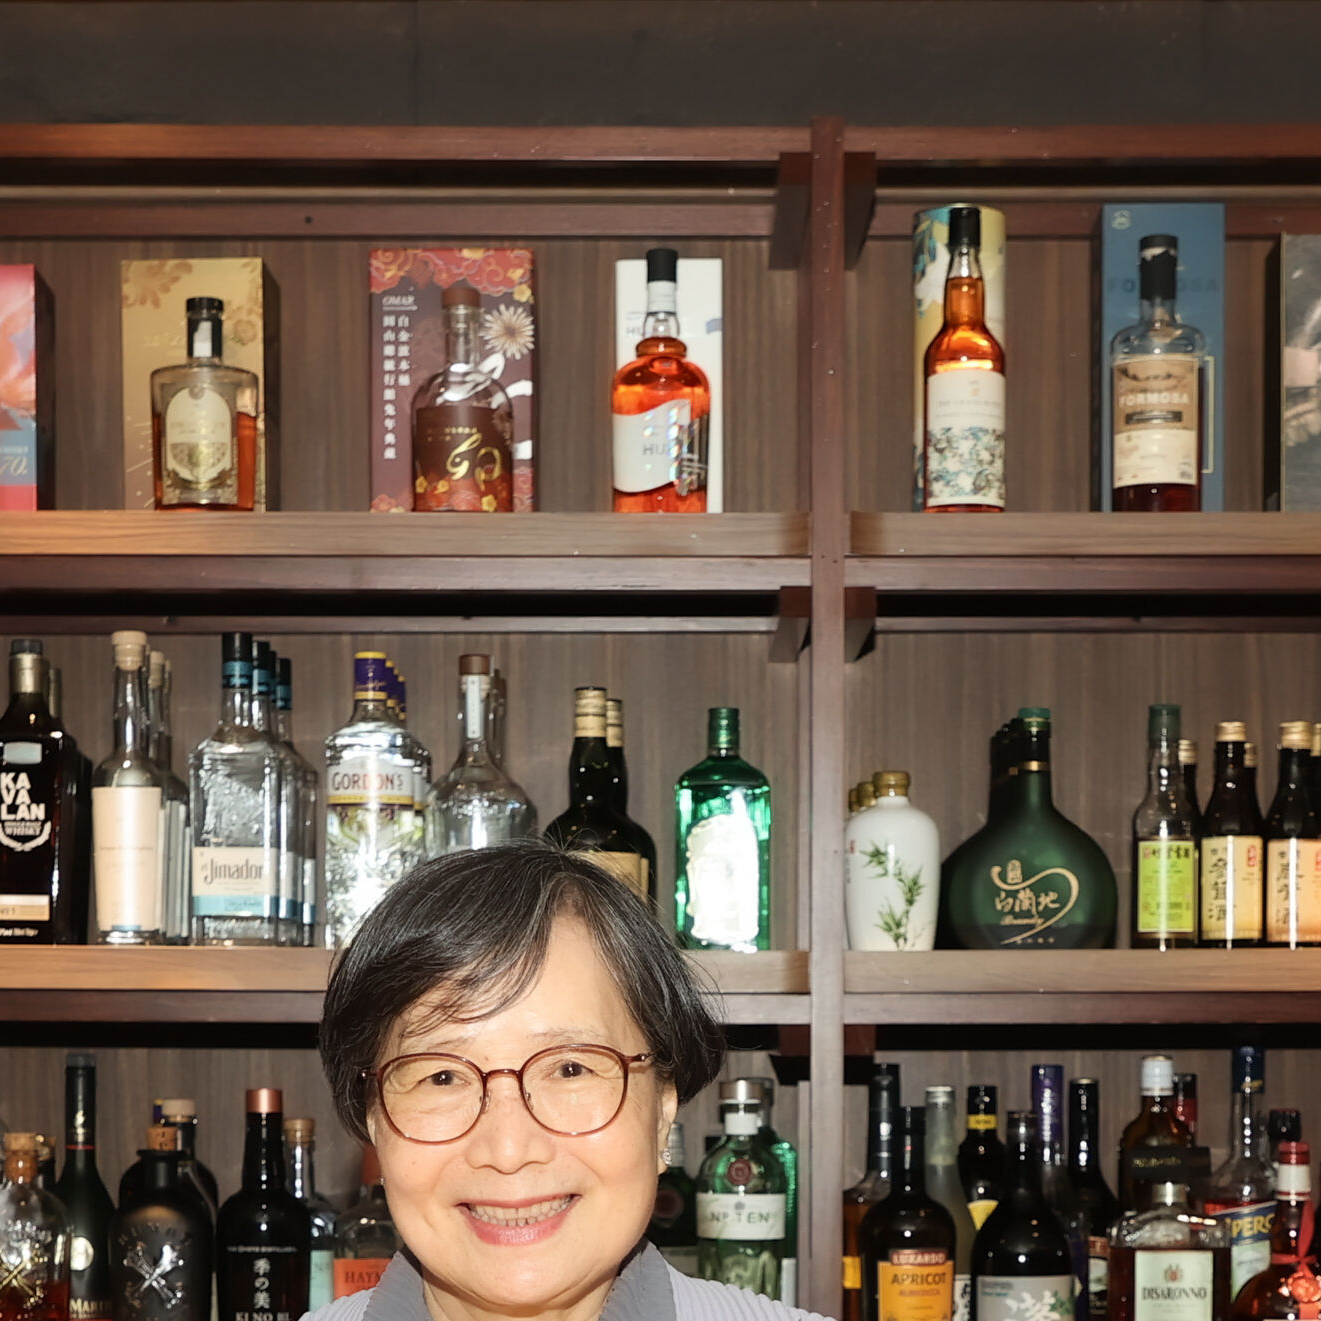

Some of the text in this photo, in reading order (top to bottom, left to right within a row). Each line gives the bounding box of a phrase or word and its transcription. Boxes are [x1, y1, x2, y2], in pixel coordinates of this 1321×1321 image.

[1118, 393, 1191, 407] FORMOSA
[0, 772, 32, 790] KA
[0, 788, 31, 805] VA
[1, 803, 46, 821] LAN
[204, 857, 263, 885] Jimador
[994, 887, 1061, 915] 白蘭地
[737, 1212, 771, 1224] TEN
[891, 1251, 947, 1266] LUXARDO
[253, 1257, 271, 1309] 季の美
[890, 1271, 947, 1287] APRICOT
[1141, 1286, 1208, 1302] DISARONNO
